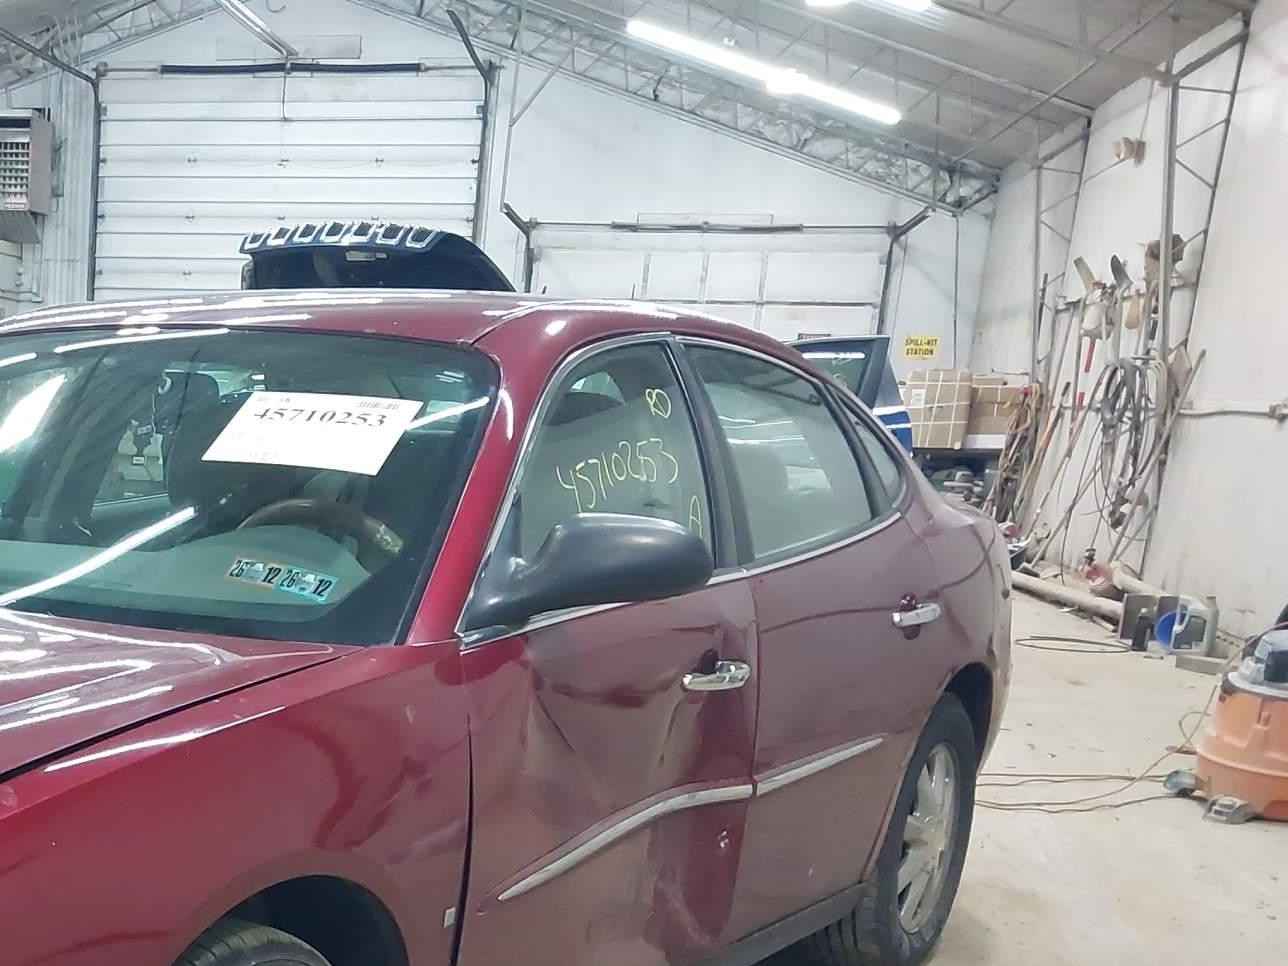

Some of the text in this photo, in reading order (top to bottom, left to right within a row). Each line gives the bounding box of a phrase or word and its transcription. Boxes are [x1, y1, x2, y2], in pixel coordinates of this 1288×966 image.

[905, 338, 938, 347] SPILL-KIT
[905, 348, 934, 356] STATION
[253, 407, 388, 427] 45710253
[556, 437, 679, 514] 45710253
[688, 494, 702, 539] A
[229, 560, 282, 585] 26 12
[279, 569, 333, 597] 26 12
